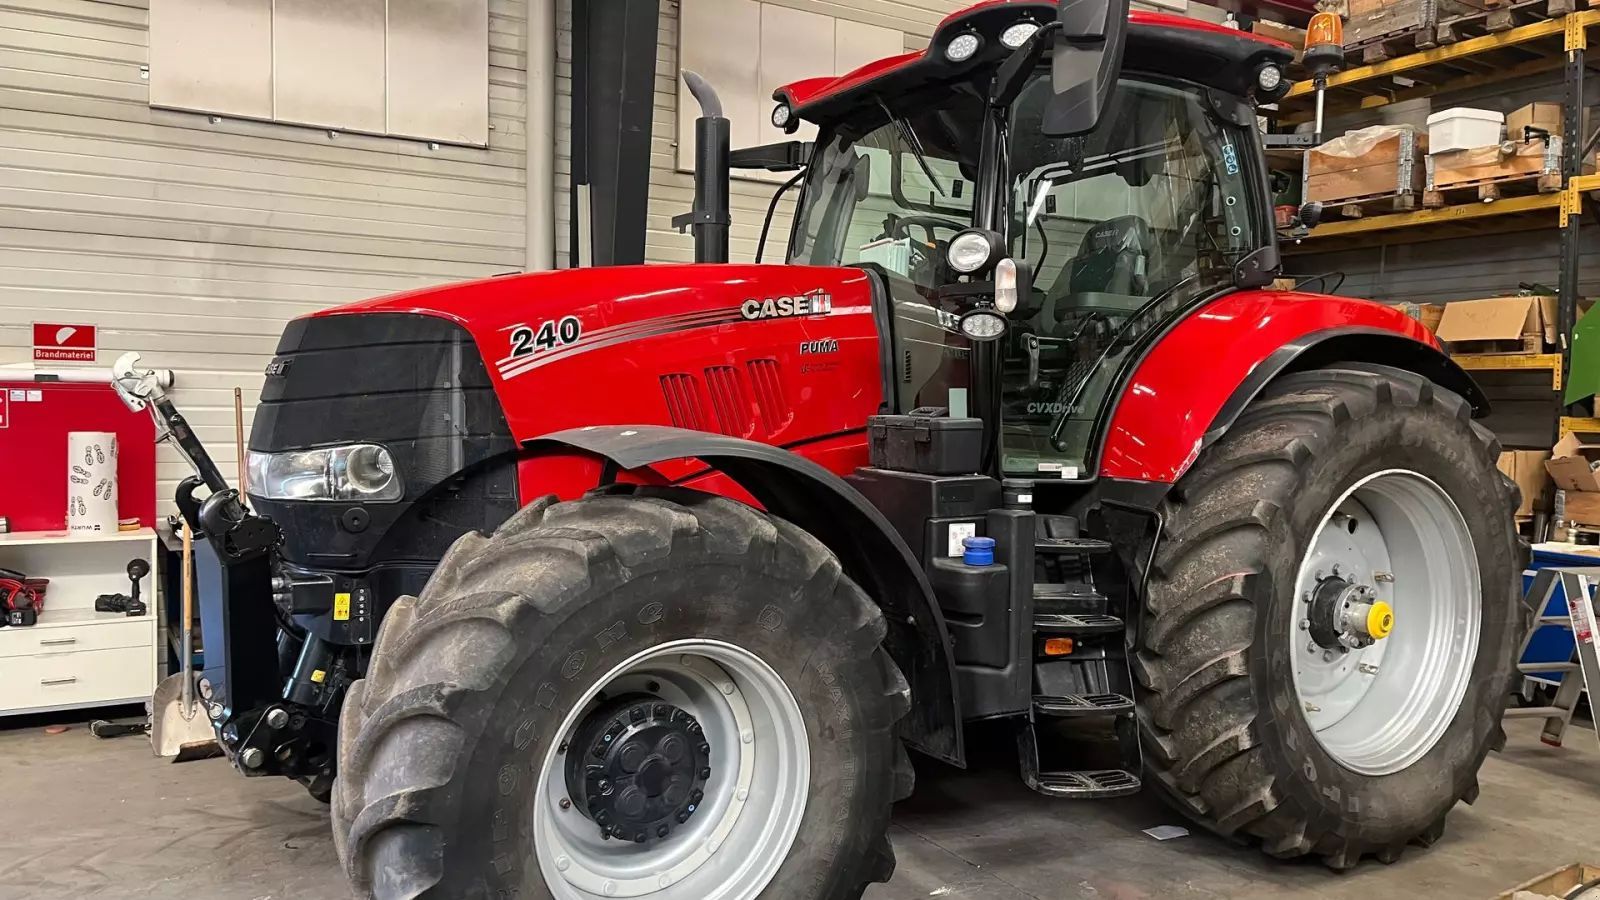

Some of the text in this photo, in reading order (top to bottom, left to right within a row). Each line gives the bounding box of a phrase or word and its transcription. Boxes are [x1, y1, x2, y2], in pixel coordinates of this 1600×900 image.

[741, 295, 809, 320] CASE
[510, 315, 581, 358] 240
[35, 350, 94, 359] Brandmateriel
[800, 339, 840, 355] PUMA
